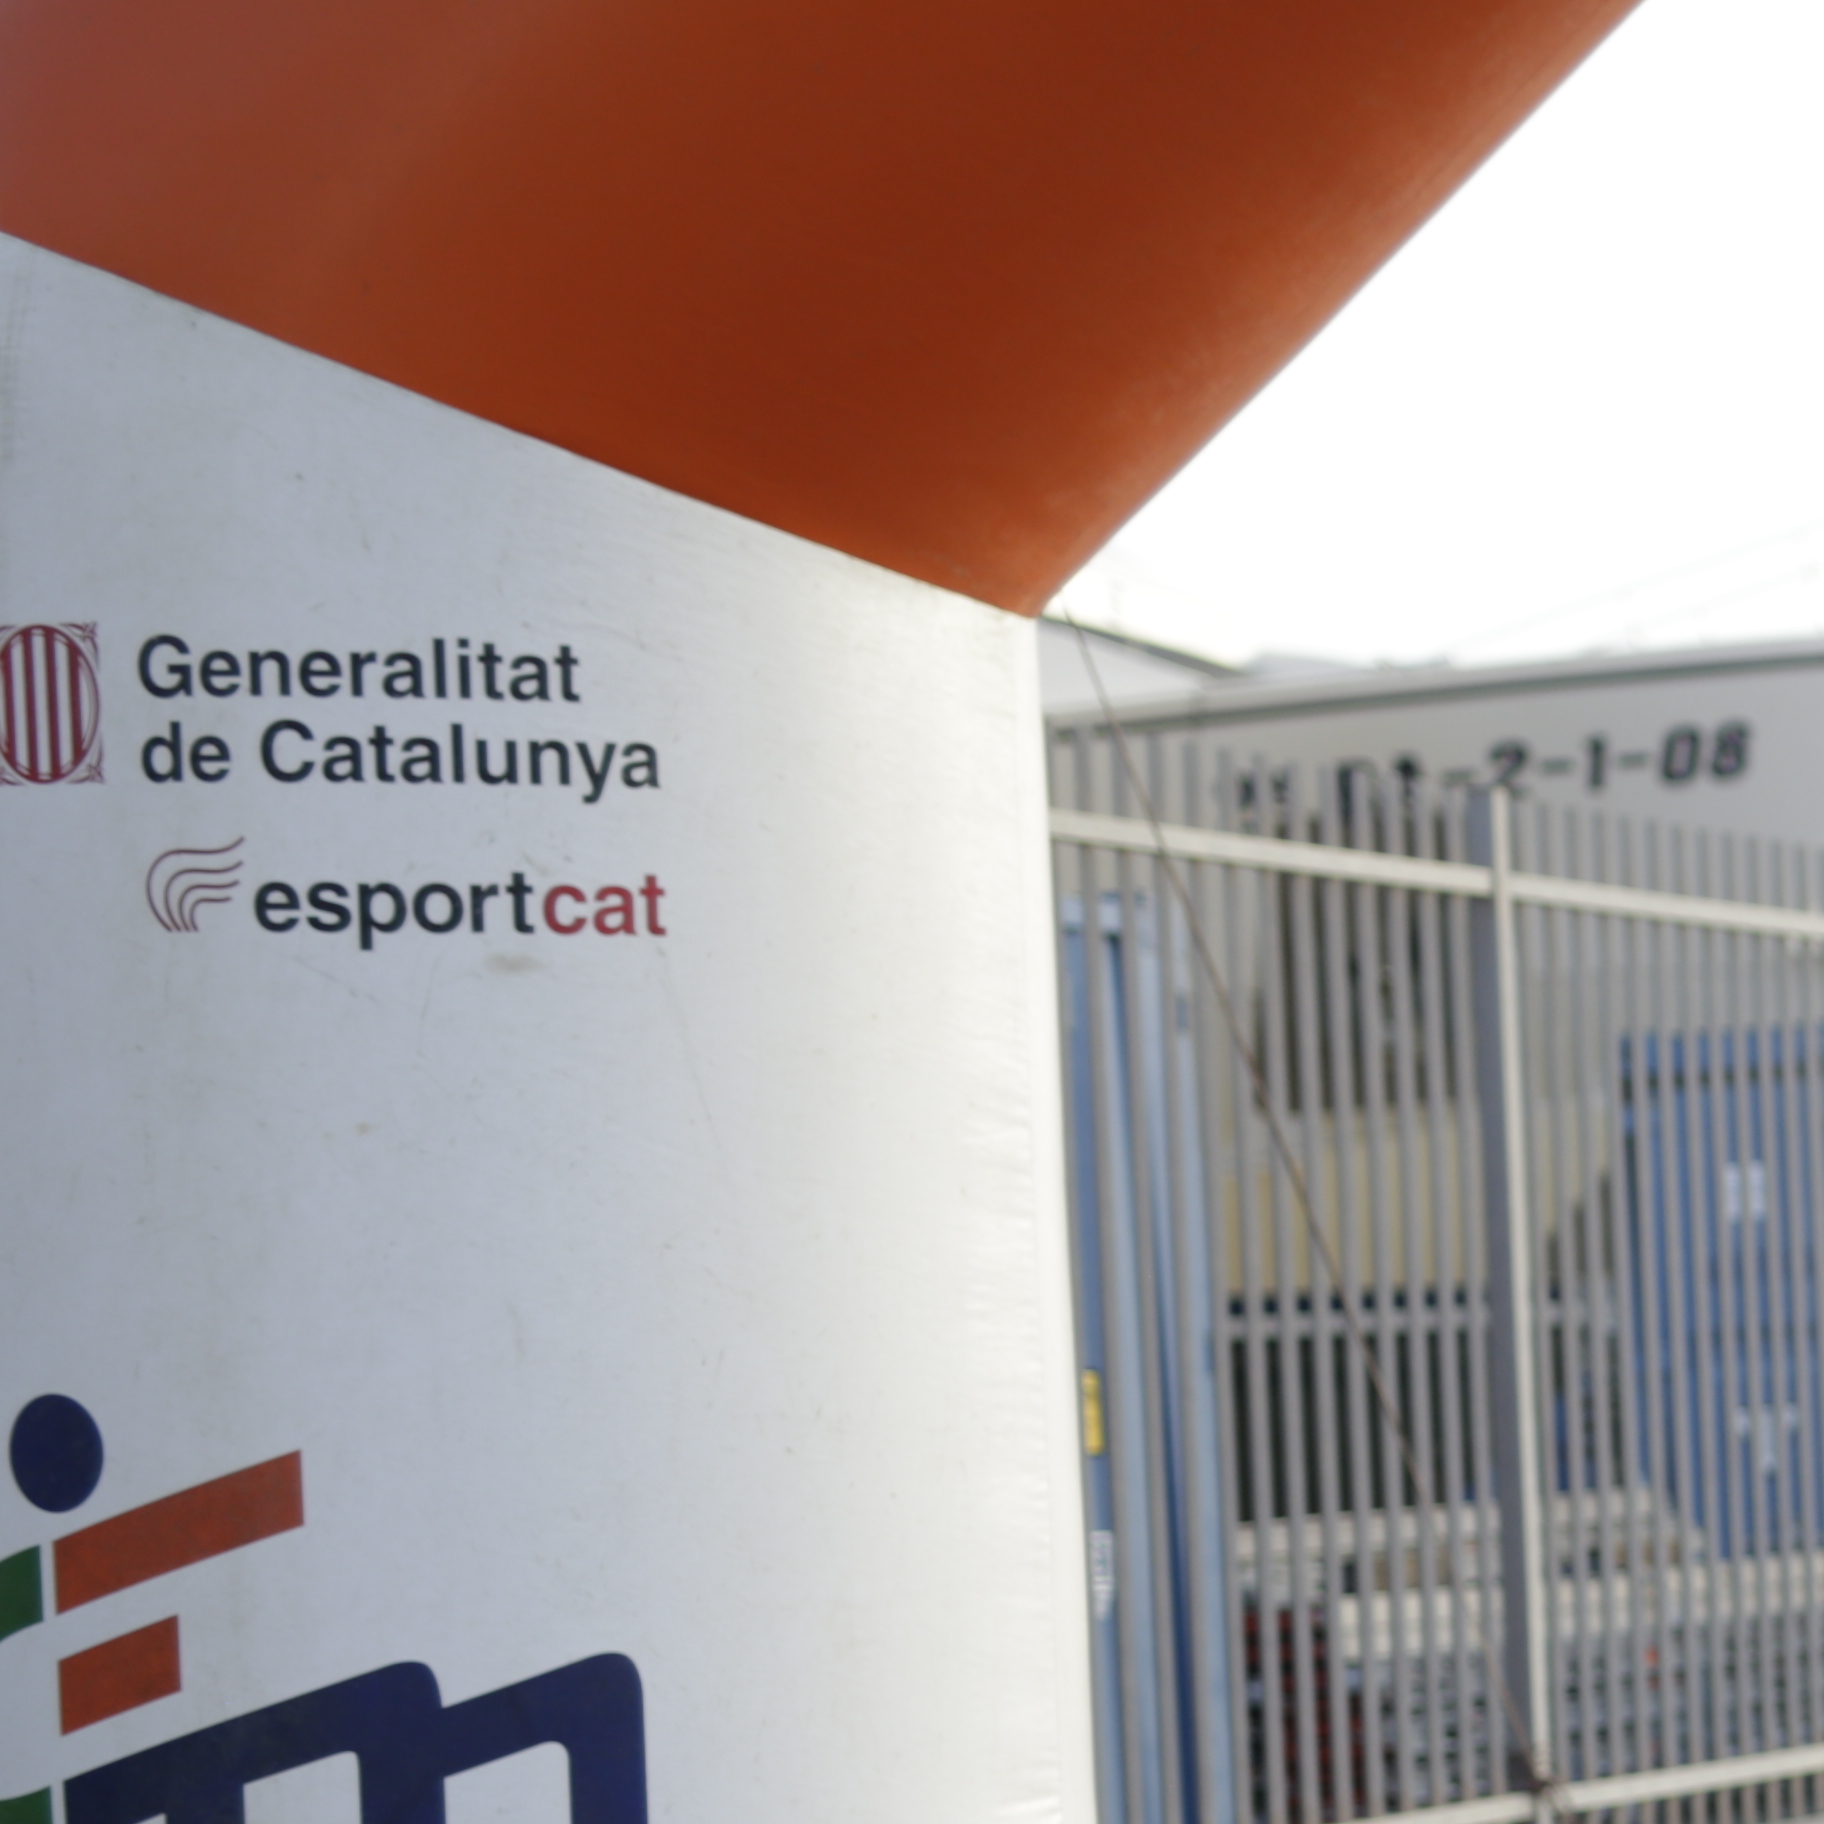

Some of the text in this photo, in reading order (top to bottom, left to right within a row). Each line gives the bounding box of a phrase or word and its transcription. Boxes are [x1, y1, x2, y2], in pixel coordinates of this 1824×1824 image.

[136, 633, 580, 703] Generalitat
[140, 718, 660, 804] de Catalunya
[253, 872, 667, 952] esportcat
